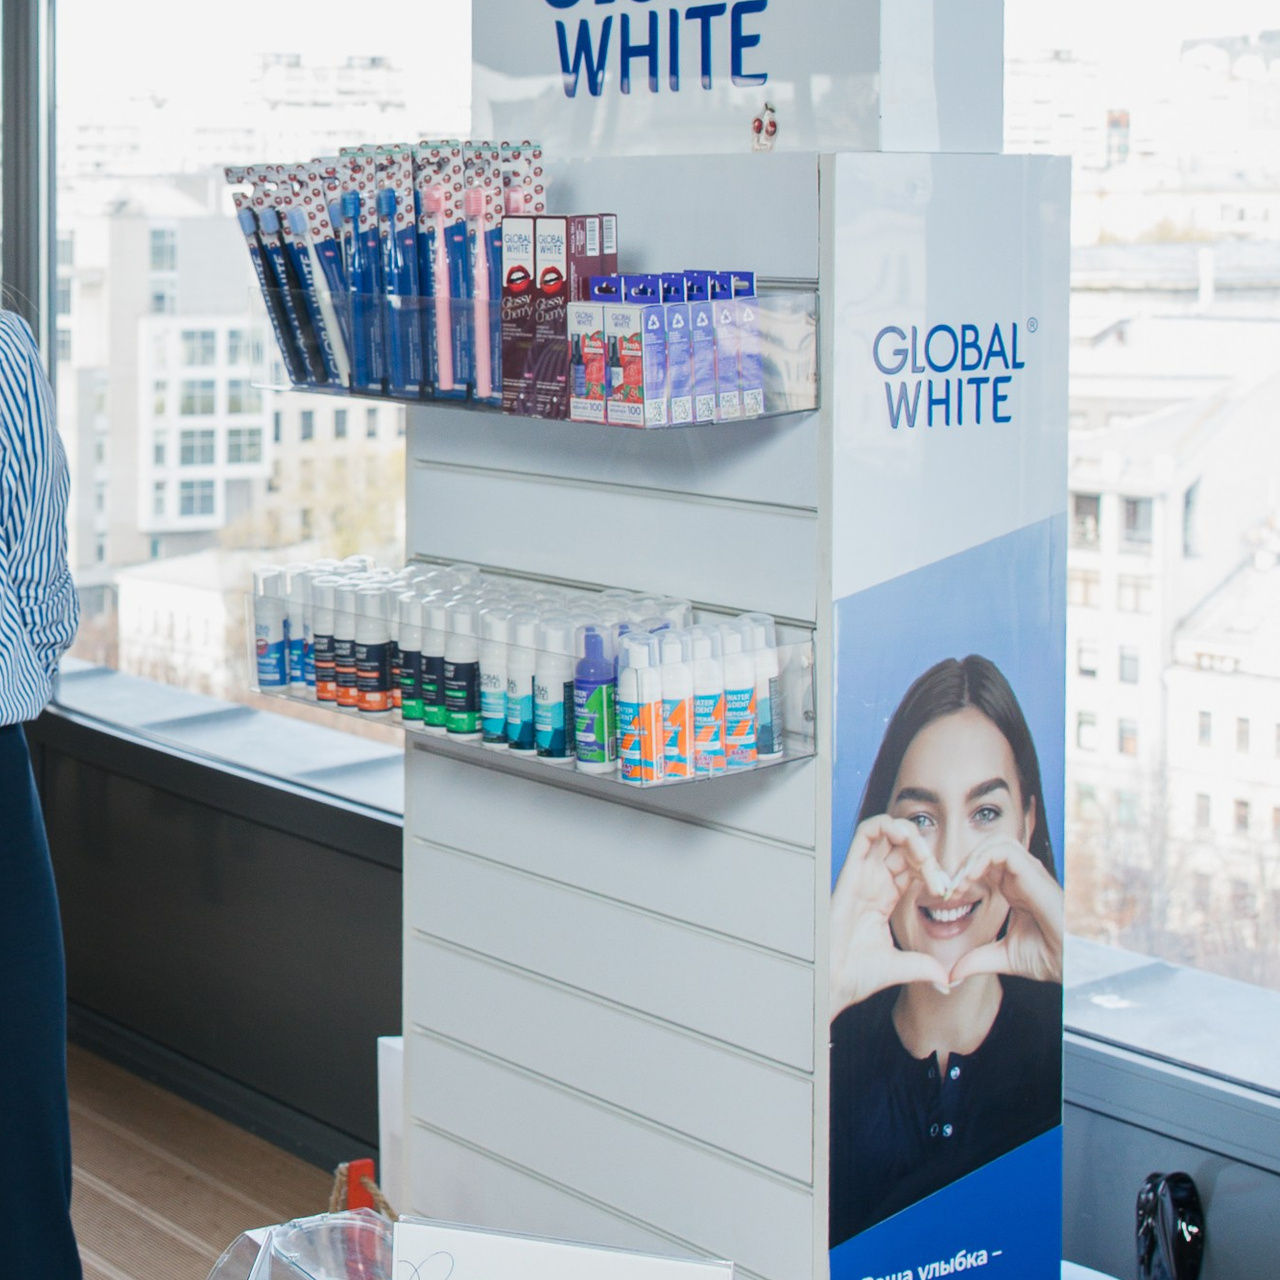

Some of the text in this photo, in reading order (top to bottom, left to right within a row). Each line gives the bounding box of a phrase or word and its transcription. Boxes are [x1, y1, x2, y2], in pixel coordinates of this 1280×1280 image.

[503, 233, 531, 244] GLOBAL
[537, 234, 564, 245] GLOBAL
[506, 244, 530, 254] WHITE
[540, 245, 562, 254] WHITE
[872, 321, 1026, 376] GLOBAL
[883, 374, 1013, 429] WHITE
[589, 402, 602, 412] 100
[627, 405, 641, 415] 100
